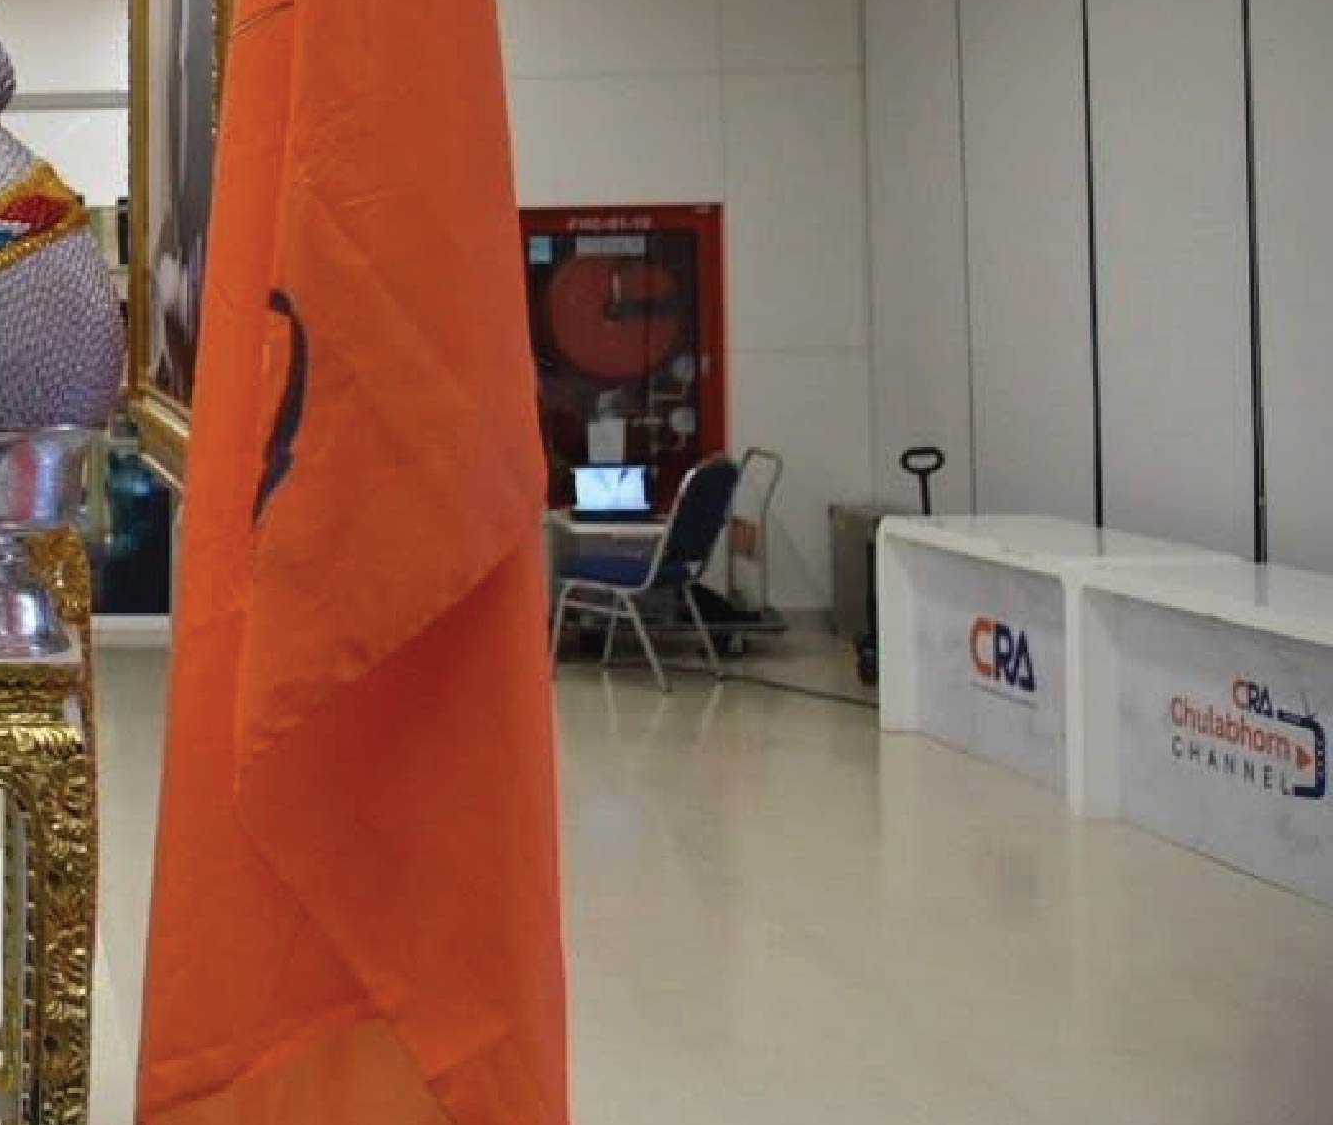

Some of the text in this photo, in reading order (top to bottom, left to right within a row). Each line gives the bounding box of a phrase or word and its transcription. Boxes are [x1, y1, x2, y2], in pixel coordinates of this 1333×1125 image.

[969, 617, 1036, 692] CRA
[1172, 696, 1291, 761] Chulabhorn
[1233, 680, 1273, 718] CRA
[1172, 735, 1291, 795] CHANNEL
